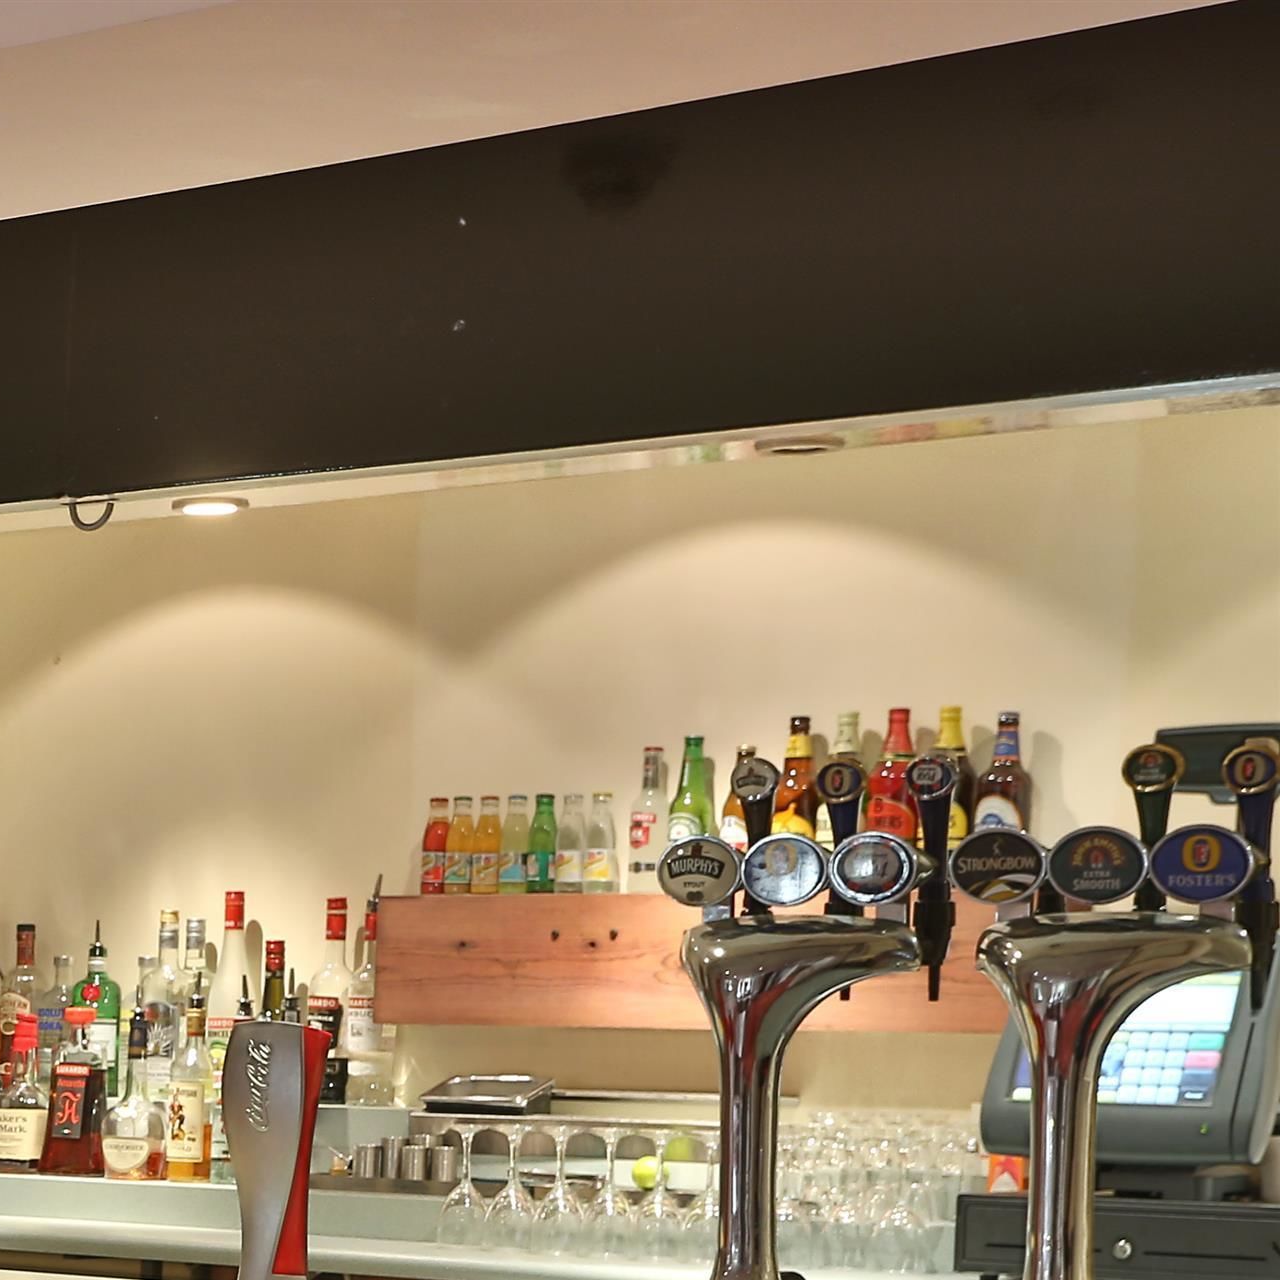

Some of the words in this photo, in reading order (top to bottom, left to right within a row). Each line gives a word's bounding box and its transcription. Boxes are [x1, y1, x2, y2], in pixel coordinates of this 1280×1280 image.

[957, 856, 1036, 873] STRONGBOW
[1083, 870, 1111, 878] EXTRA
[1168, 874, 1237, 887] FOSTER'S
[1073, 878, 1121, 891] SMOOTH
